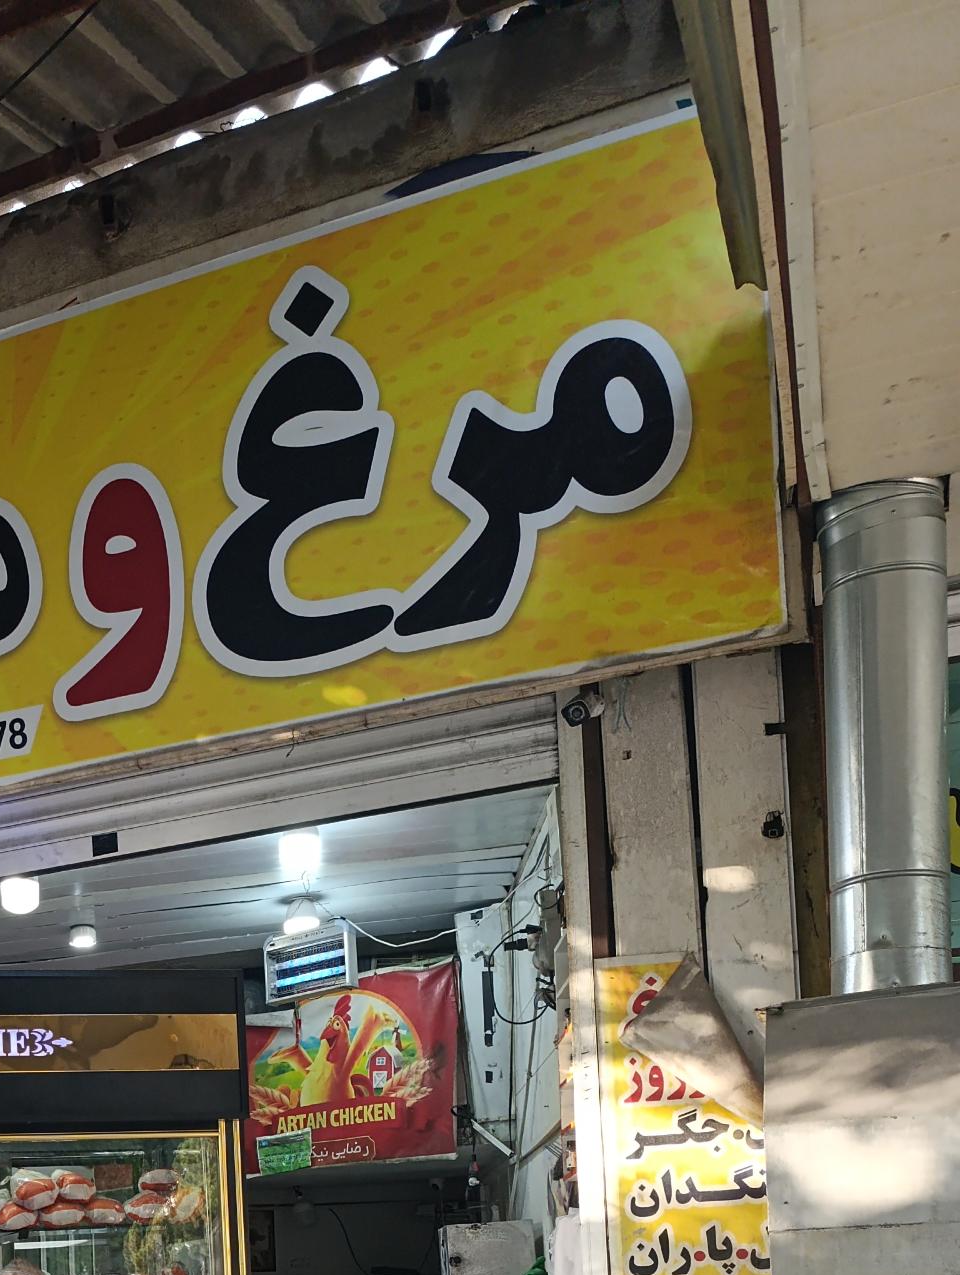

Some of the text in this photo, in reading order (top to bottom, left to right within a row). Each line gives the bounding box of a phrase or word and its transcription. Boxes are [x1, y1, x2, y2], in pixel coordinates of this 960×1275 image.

[205, 280, 676, 663] مرغ
[65, 477, 172, 708] و
[277, 1101, 396, 1134] ARTAN CHICKEN
[625, 1108, 730, 1160] جگر
[331, 1141, 369, 1160] رضایی
[629, 1164, 767, 1218] نگدان
